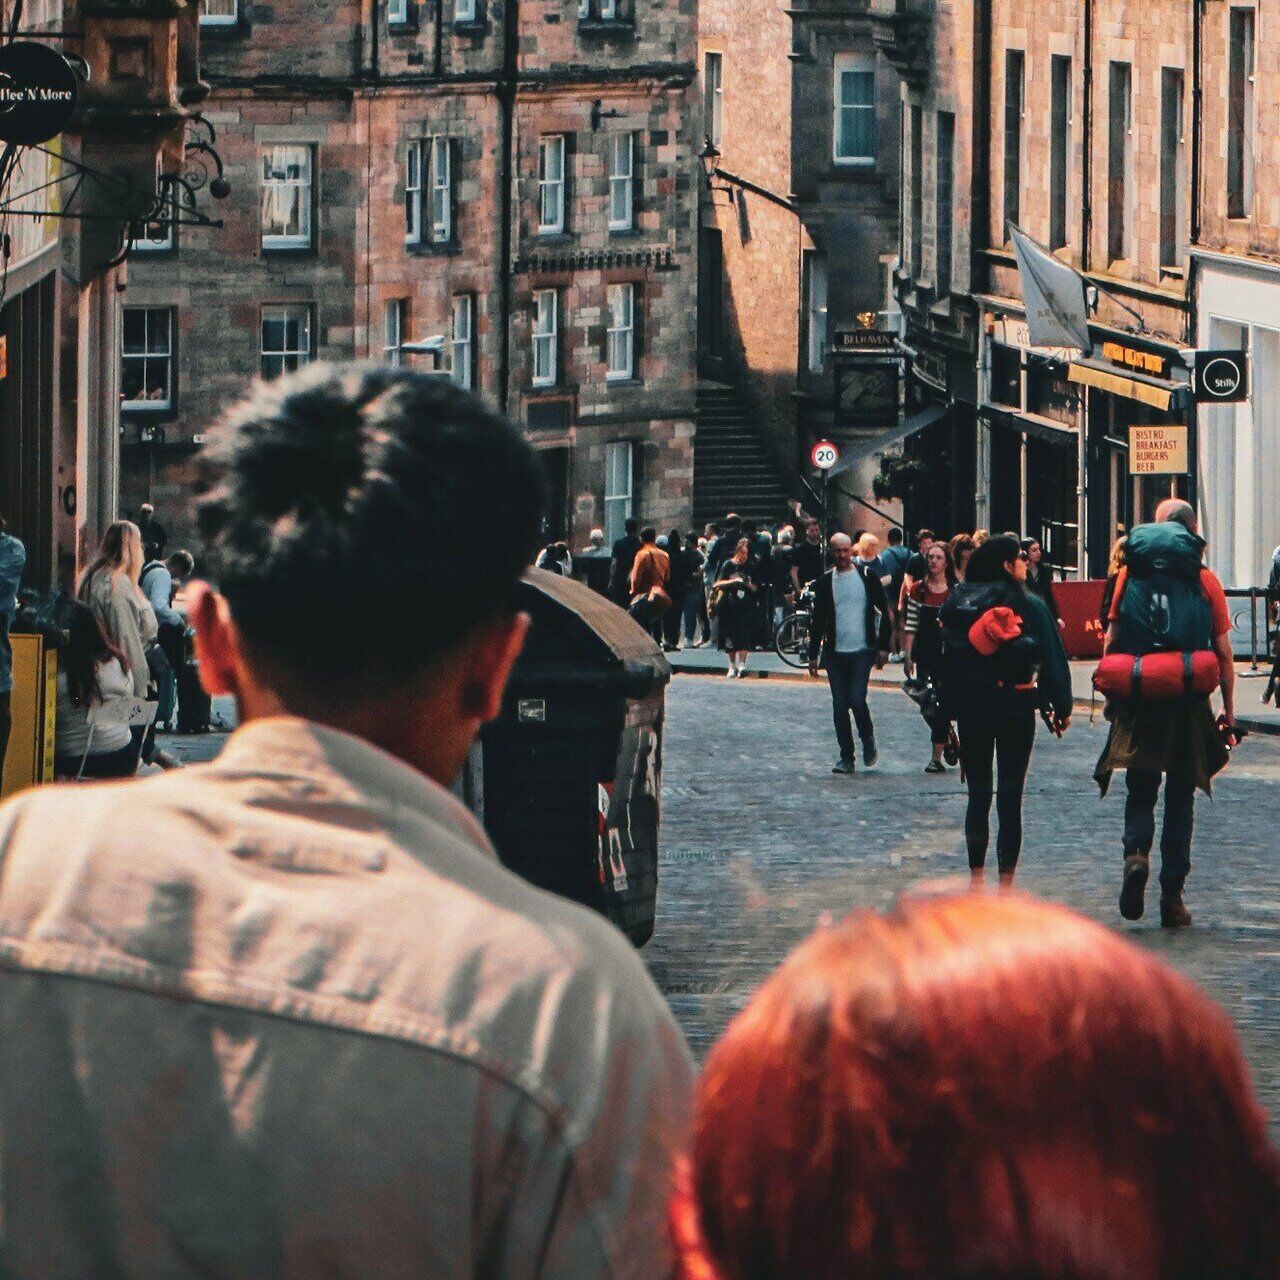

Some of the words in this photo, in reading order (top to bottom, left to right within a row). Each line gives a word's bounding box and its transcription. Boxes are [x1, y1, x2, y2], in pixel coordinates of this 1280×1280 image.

[40, 88, 72, 101] More
[843, 334, 890, 345] BELHAVEN
[1135, 430, 1164, 440] BISTRO
[1135, 440, 1177, 450] BREAKFAST
[817, 450, 834, 461] 20
[1136, 451, 1169, 461] BURGERS
[1136, 462, 1155, 471] BEER
